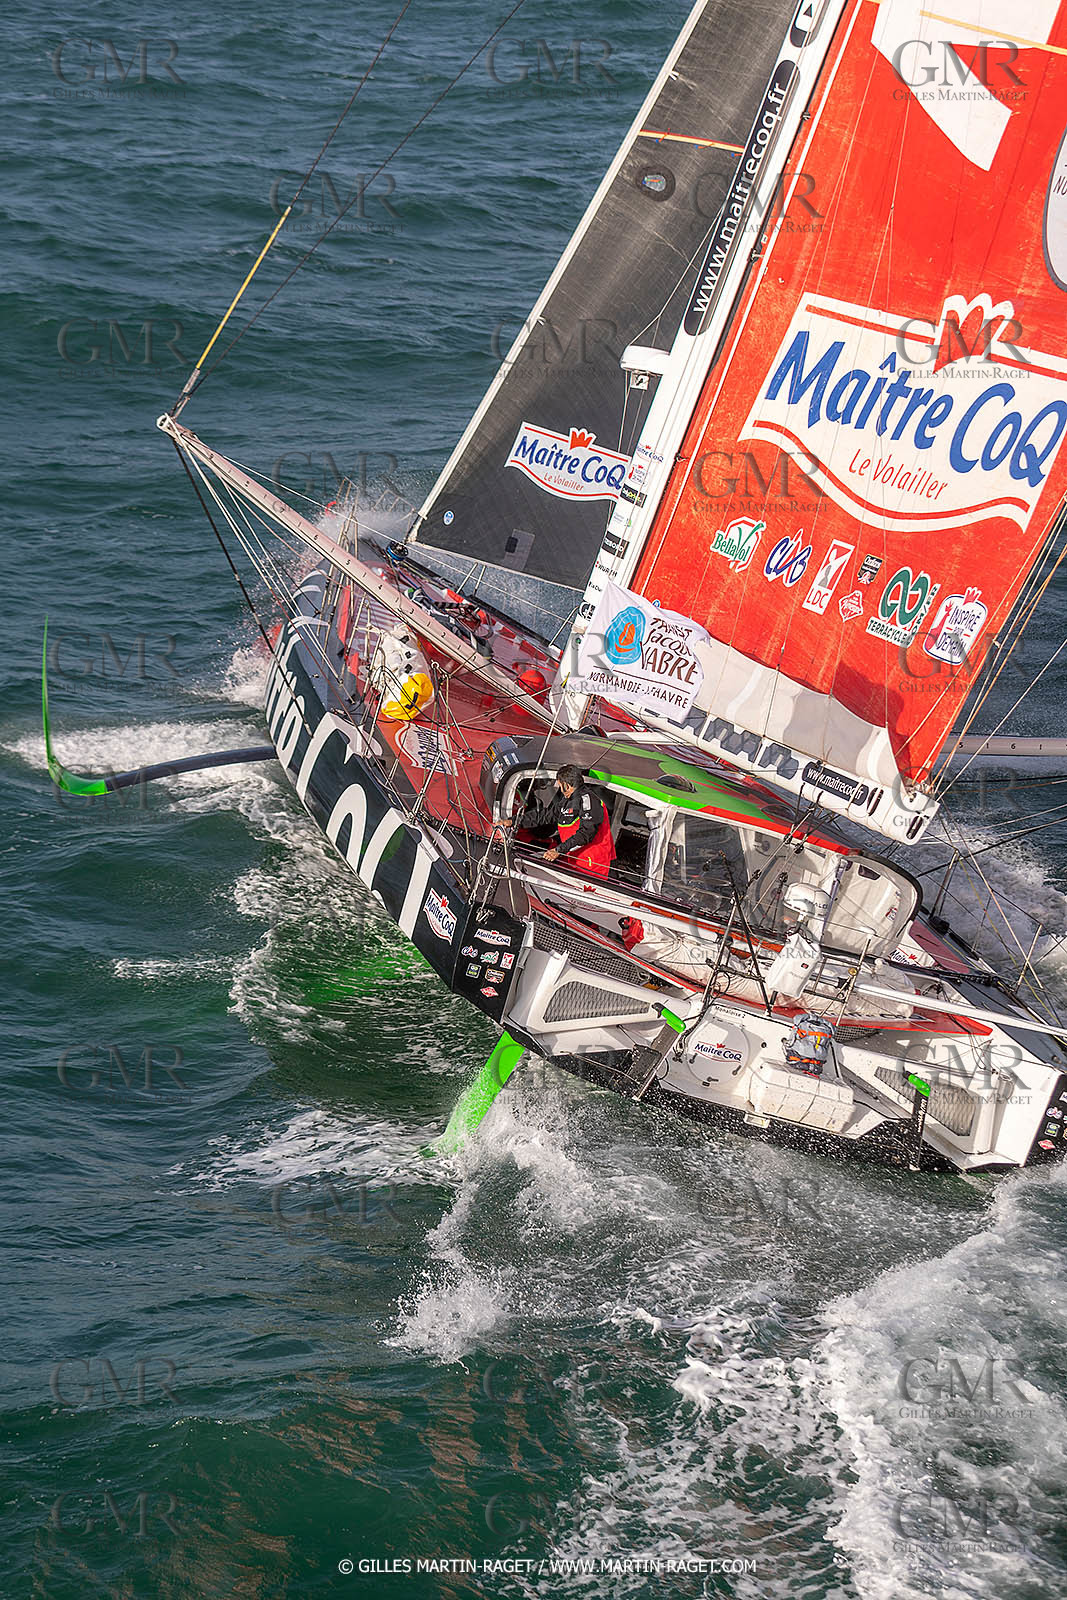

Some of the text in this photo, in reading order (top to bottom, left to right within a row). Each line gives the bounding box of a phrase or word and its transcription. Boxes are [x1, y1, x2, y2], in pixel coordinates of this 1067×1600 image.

[693, 82, 788, 313] www.maitrecoq.fr
[765, 330, 1067, 488] Maître CoQ
[514, 435, 580, 475] Maître
[581, 456, 626, 490] CoQ
[553, 473, 584, 491] Volailler
[849, 449, 949, 501] Le Volailler
[806, 588, 829, 609] LDC
[640, 640, 698, 685] VABRE
[806, 767, 864, 800] www.maitrecoqfr
[425, 894, 443, 923] Maître
[441, 913, 455, 937] CoQ
[496, 935, 510, 944] CoQ
[694, 1043, 742, 1062] Maître CoQ
